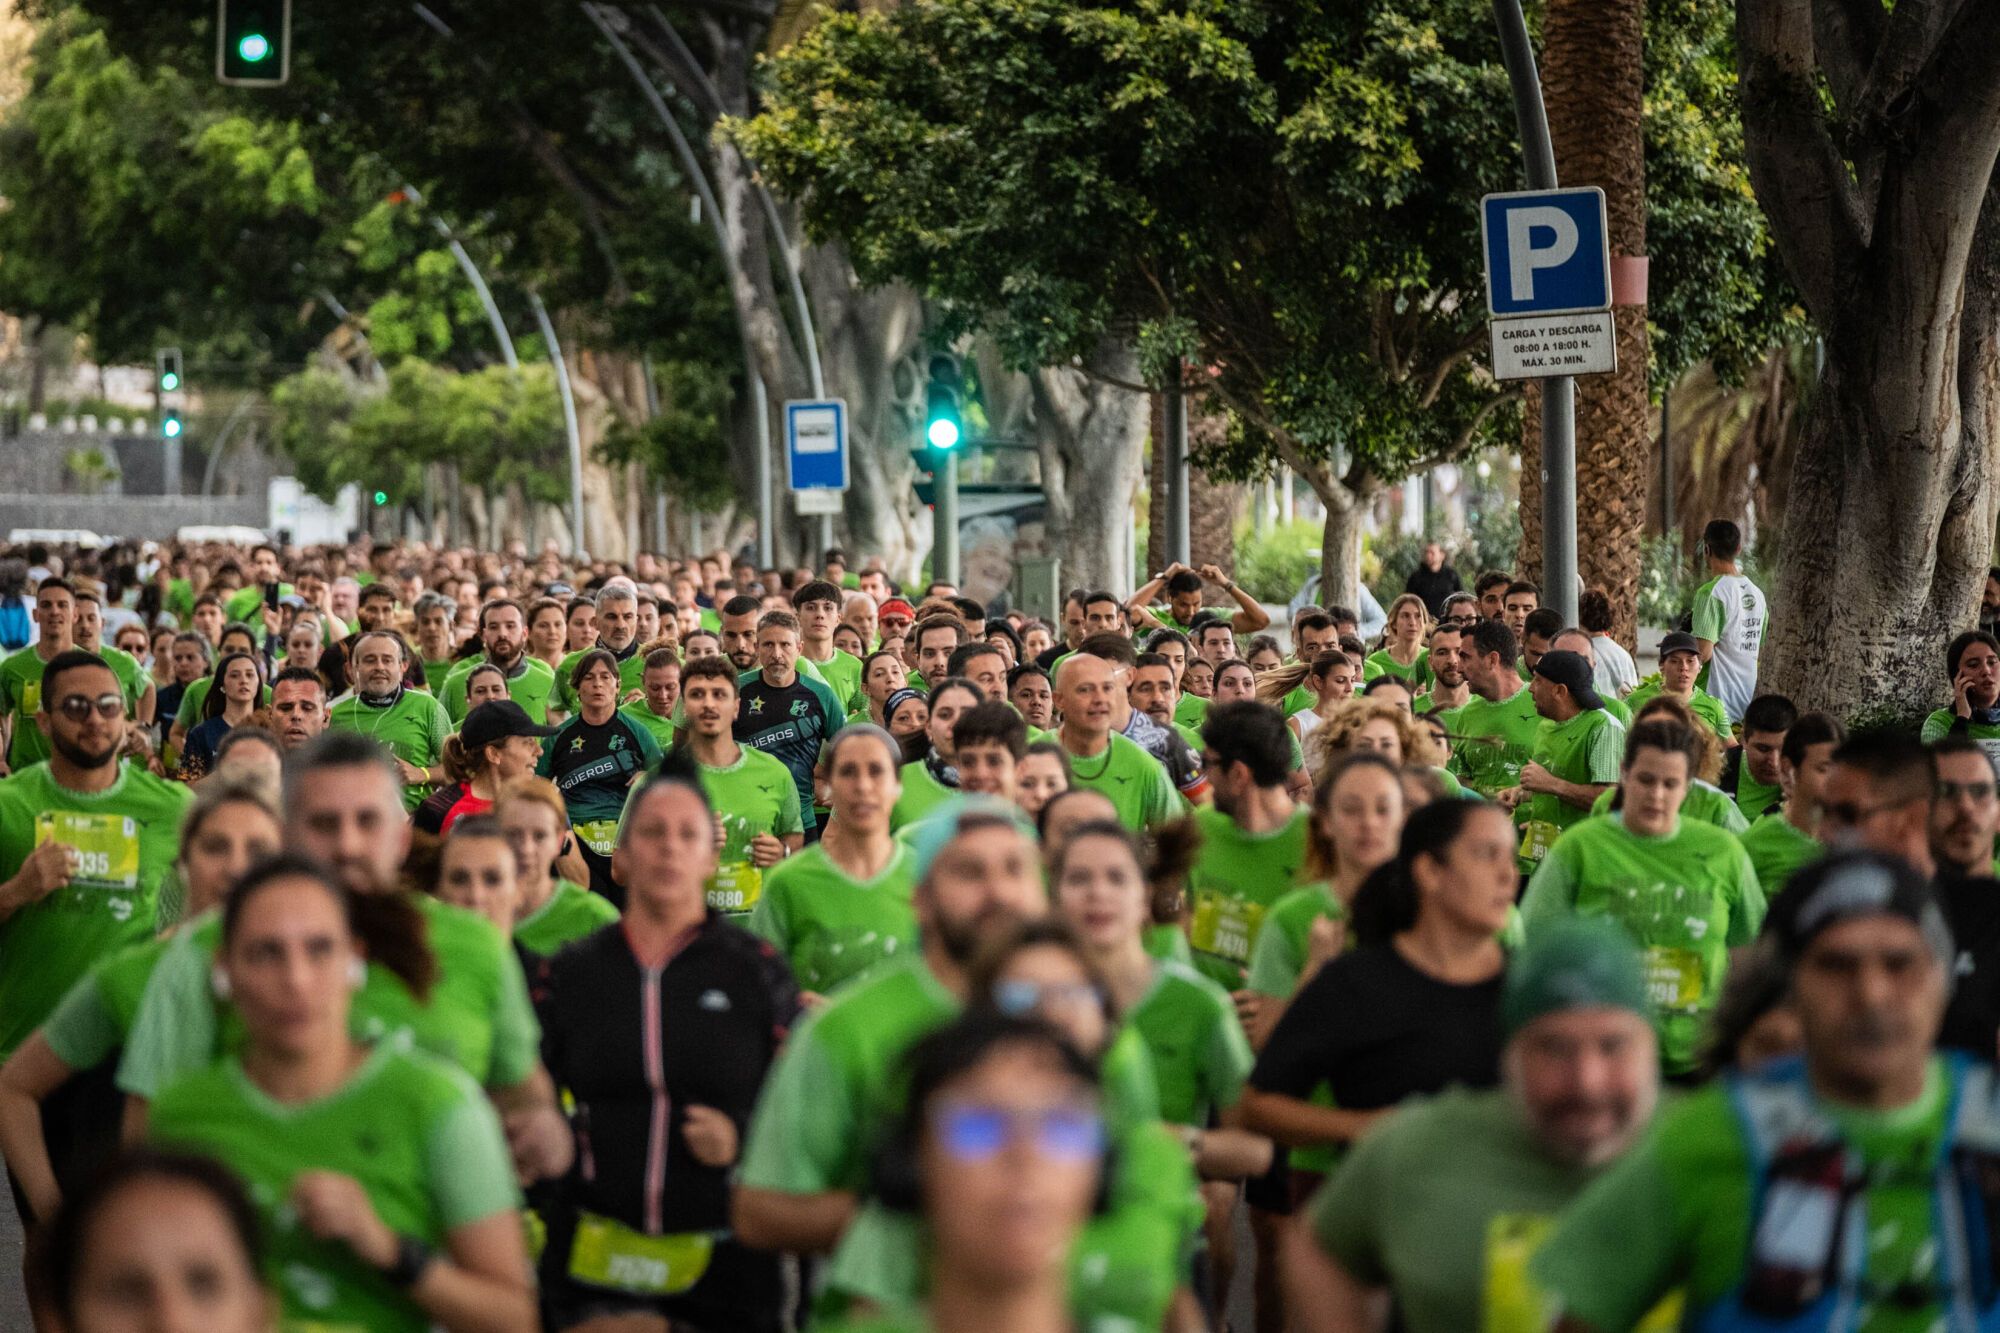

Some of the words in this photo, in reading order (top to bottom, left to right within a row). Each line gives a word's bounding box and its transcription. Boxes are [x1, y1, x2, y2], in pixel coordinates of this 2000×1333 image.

[1506, 206, 1579, 301] P
[1502, 329, 1536, 339] CARGA
[1539, 328, 1545, 337] Y
[1549, 324, 1602, 336] DESCARGA
[1513, 344, 1540, 353] 08:00
[1543, 343, 1549, 351] A
[1552, 341, 1578, 350] 18:00
[1581, 340, 1591, 349] H.
[1550, 357, 1561, 366] 30
[1564, 355, 1586, 365] MIN.
[747, 728, 794, 749] ÜEROS
[561, 761, 614, 790] GÜEROS
[707, 890, 744, 907] 6880
